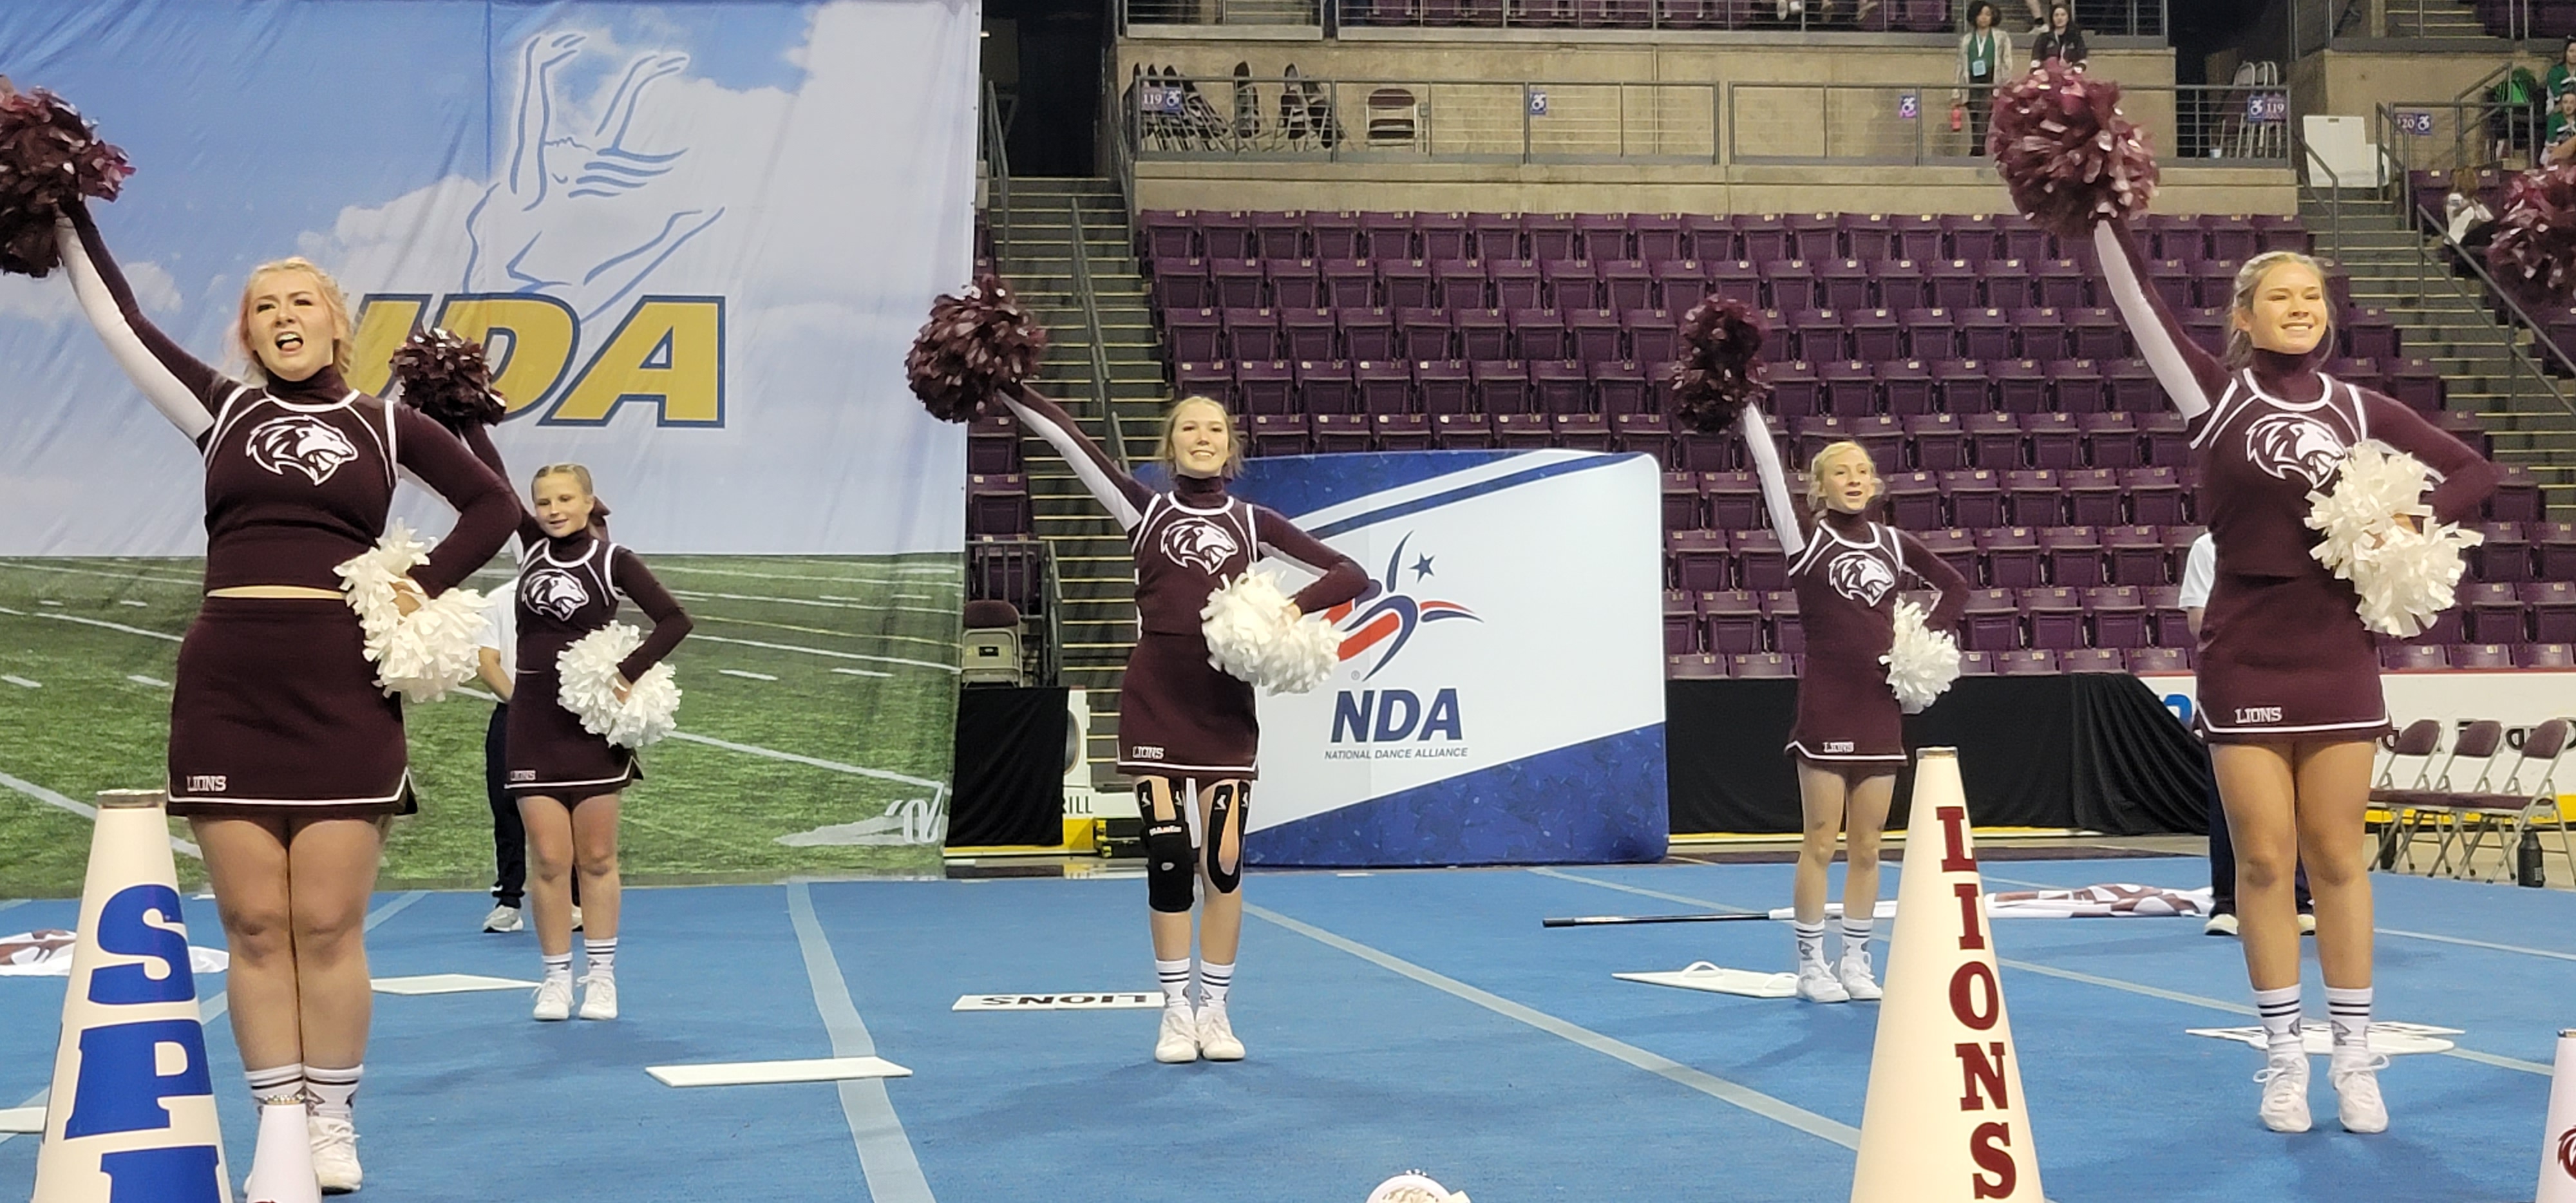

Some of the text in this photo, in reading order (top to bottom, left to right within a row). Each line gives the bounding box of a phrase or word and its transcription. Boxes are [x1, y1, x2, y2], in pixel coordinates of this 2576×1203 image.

[1143, 93, 1162, 104] 119
[2267, 103, 2285, 113] 119
[1329, 687, 1463, 743] NDA
[2233, 706, 2283, 725] LIONS
[1132, 746, 1165, 759] LIONS
[1324, 747, 1468, 760] NATIONAL DANCE ALLIANCE
[186, 775, 227, 792] LIONS
[981, 995, 1147, 1005] LIONS
[1935, 806, 2017, 1200] LIONS
